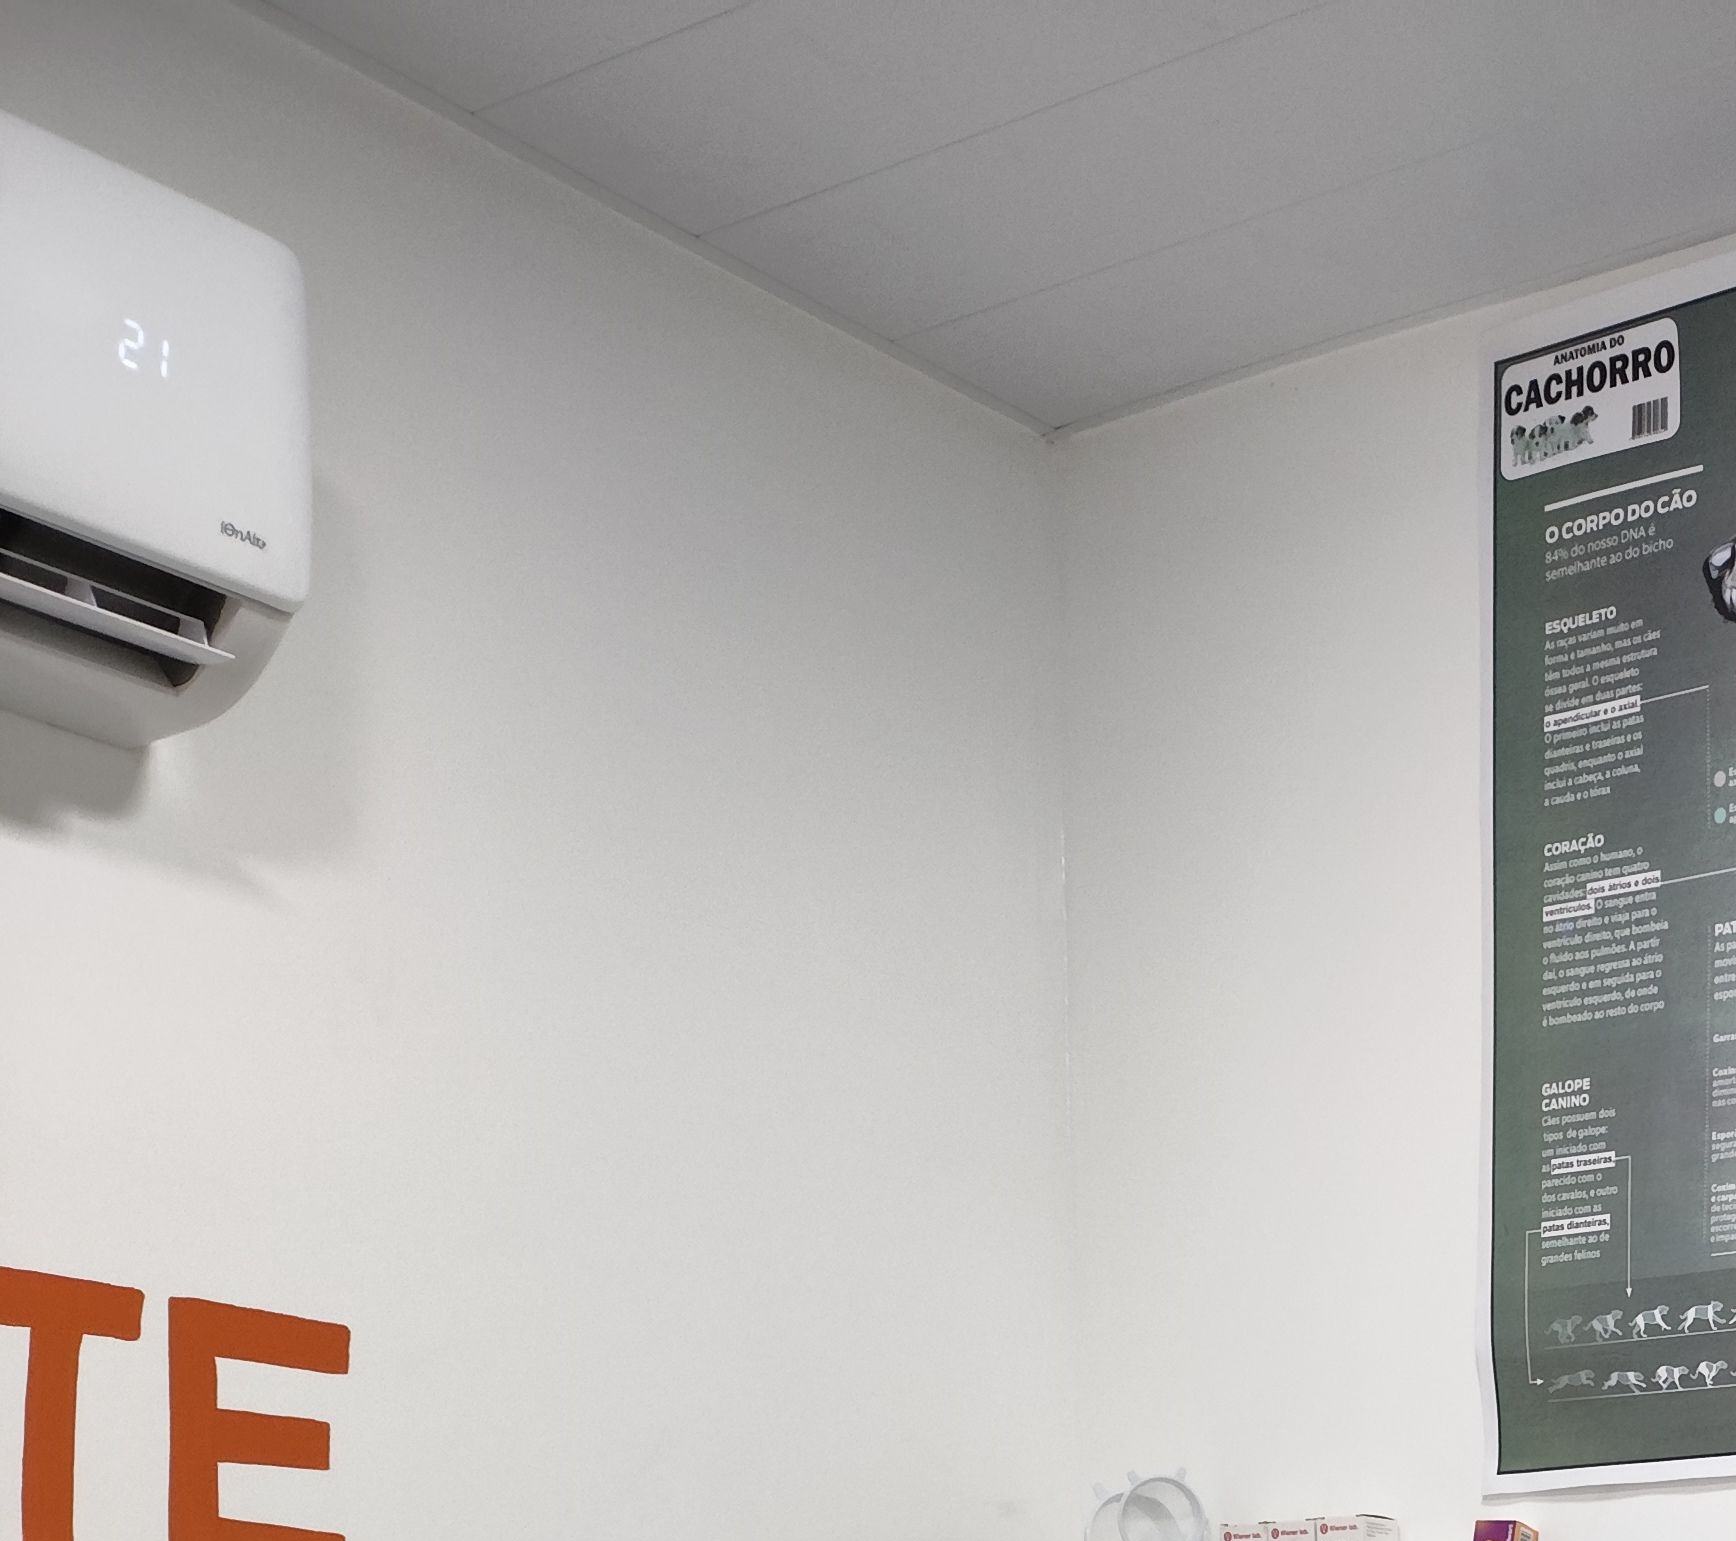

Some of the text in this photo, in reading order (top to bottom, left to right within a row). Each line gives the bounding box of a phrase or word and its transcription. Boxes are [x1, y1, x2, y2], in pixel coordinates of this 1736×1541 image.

[118, 317, 169, 378] 21
[1554, 335, 1624, 365] ANATOMIA DO
[1504, 339, 1675, 416] CACHORRO
[1545, 488, 1697, 543] O CORPO DO CÃO
[1545, 606, 1617, 635] ESQUELETO
[1544, 833, 1605, 857] CORAÇÃO
[1541, 1077, 1591, 1097] GALOPE
[1541, 1093, 1590, 1112] CANINO
[1551, 1158, 1574, 1172] patas
[1542, 1222, 1564, 1235] patas
